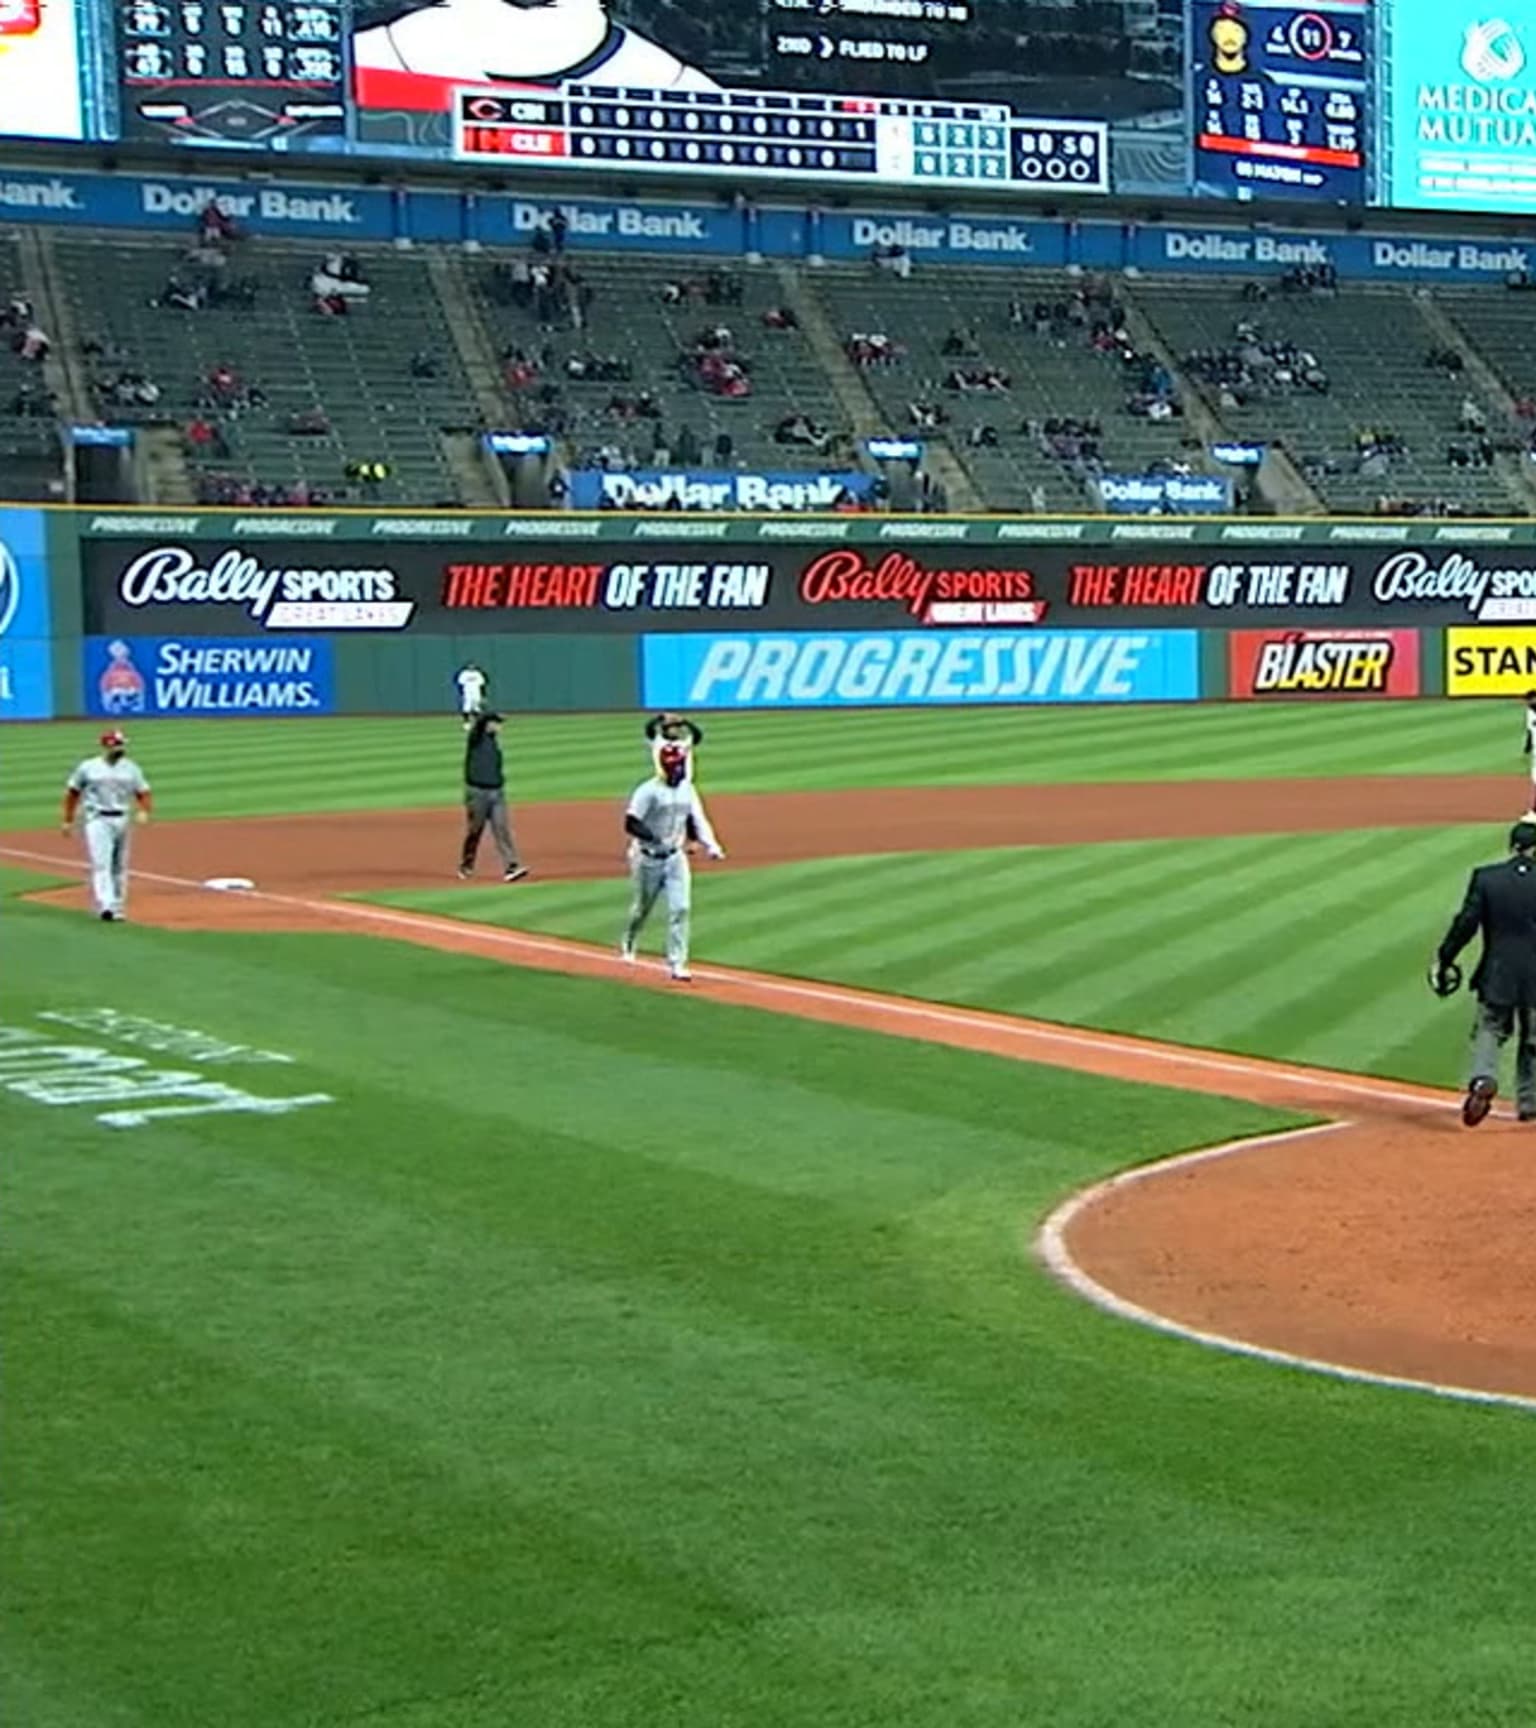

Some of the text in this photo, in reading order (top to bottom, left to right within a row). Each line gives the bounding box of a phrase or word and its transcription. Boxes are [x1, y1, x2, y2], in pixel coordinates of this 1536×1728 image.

[885, 43, 906, 60] TO
[0, 179, 78, 209] ank
[144, 185, 353, 221] Dollar Bank
[618, 208, 703, 237] Bank
[853, 220, 1029, 250] Dollar Bank
[1166, 233, 1327, 263] Dollar Bank
[1374, 243, 1526, 270] Dollar Bank
[602, 474, 842, 511] Dollar Bank
[1100, 480, 1162, 500] Dollar
[121, 547, 395, 617] Bally SPORTS
[446, 565, 769, 606] THE HEART OF THE FAN
[801, 550, 931, 614] Bally
[936, 571, 1031, 598] SPORTS
[1070, 565, 1348, 605] THE HEART OF THE FAN
[1374, 552, 1490, 611] Bally
[156, 642, 312, 675] SHERWIN
[689, 636, 1148, 700] PROGRESSIVE
[1254, 642, 1390, 689] BLASTER
